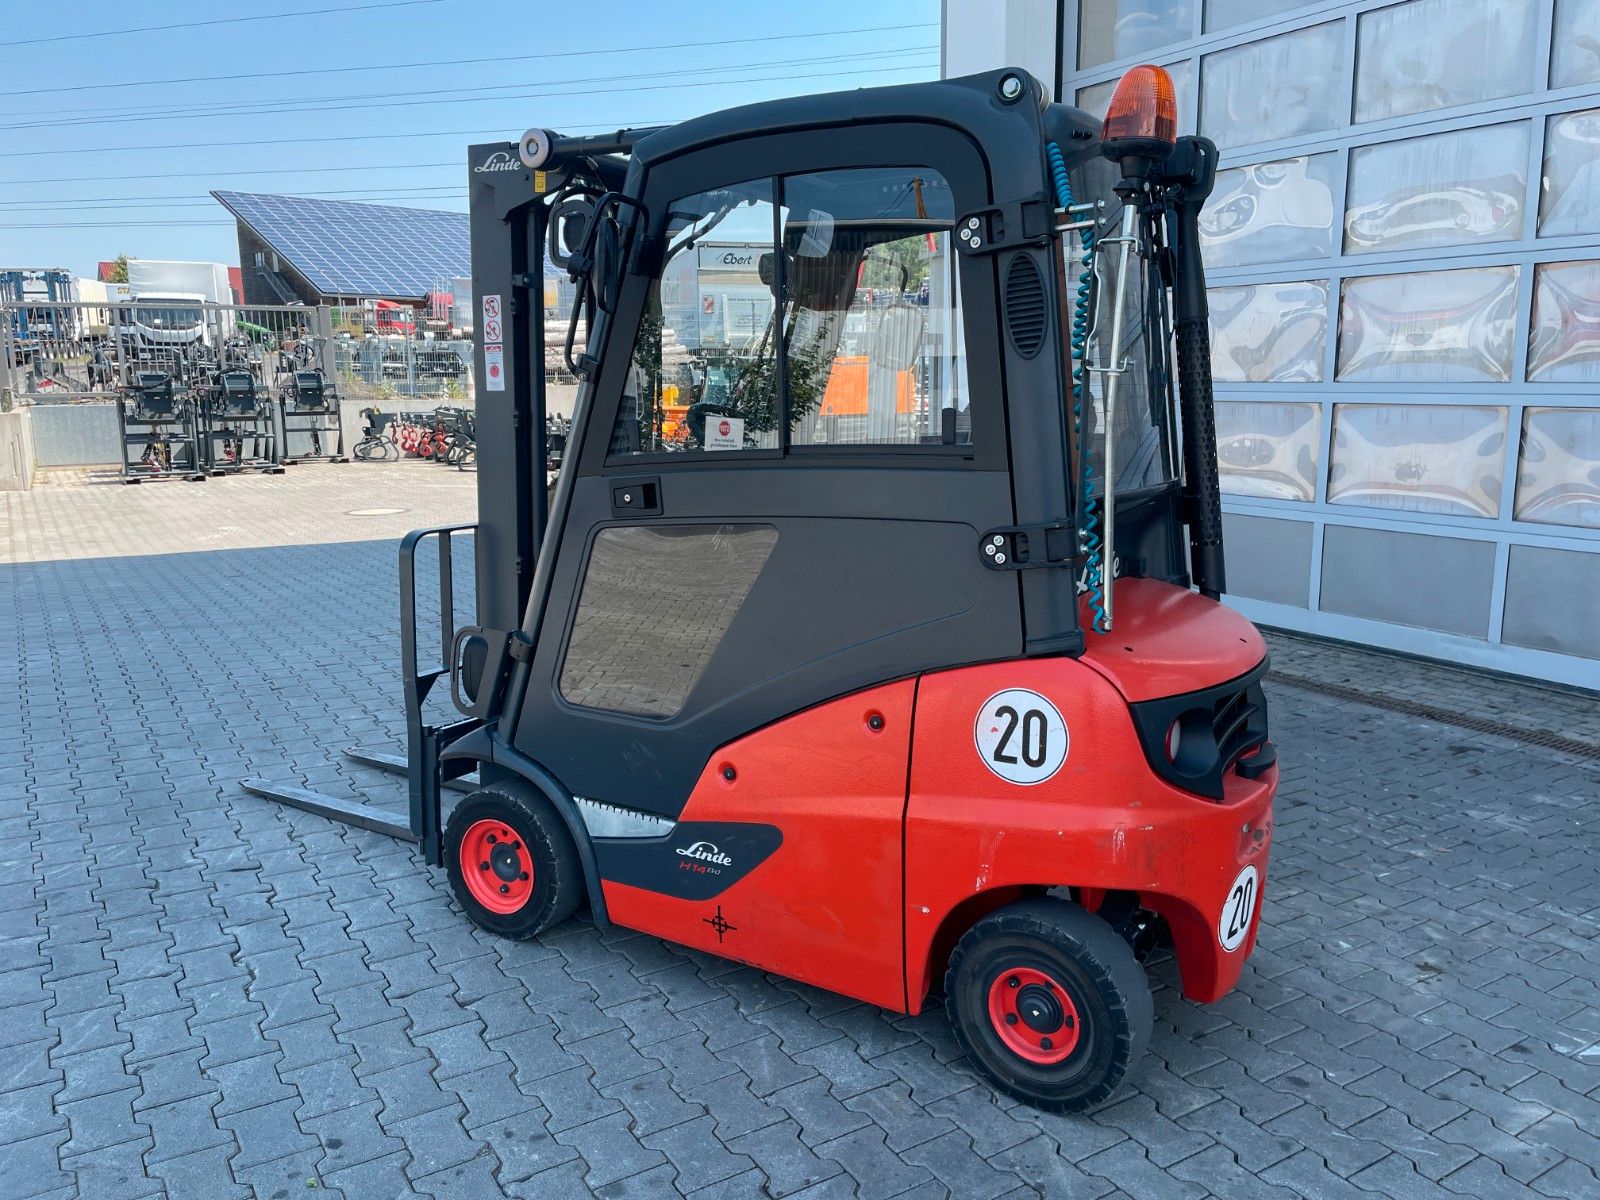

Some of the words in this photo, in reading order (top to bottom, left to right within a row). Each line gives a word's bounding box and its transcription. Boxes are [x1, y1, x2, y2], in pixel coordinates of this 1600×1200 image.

[474, 152, 521, 173] Linde
[723, 253, 752, 265] Ebert
[993, 705, 1048, 769] 20
[675, 841, 732, 866] Linde
[1227, 876, 1253, 940] 20
